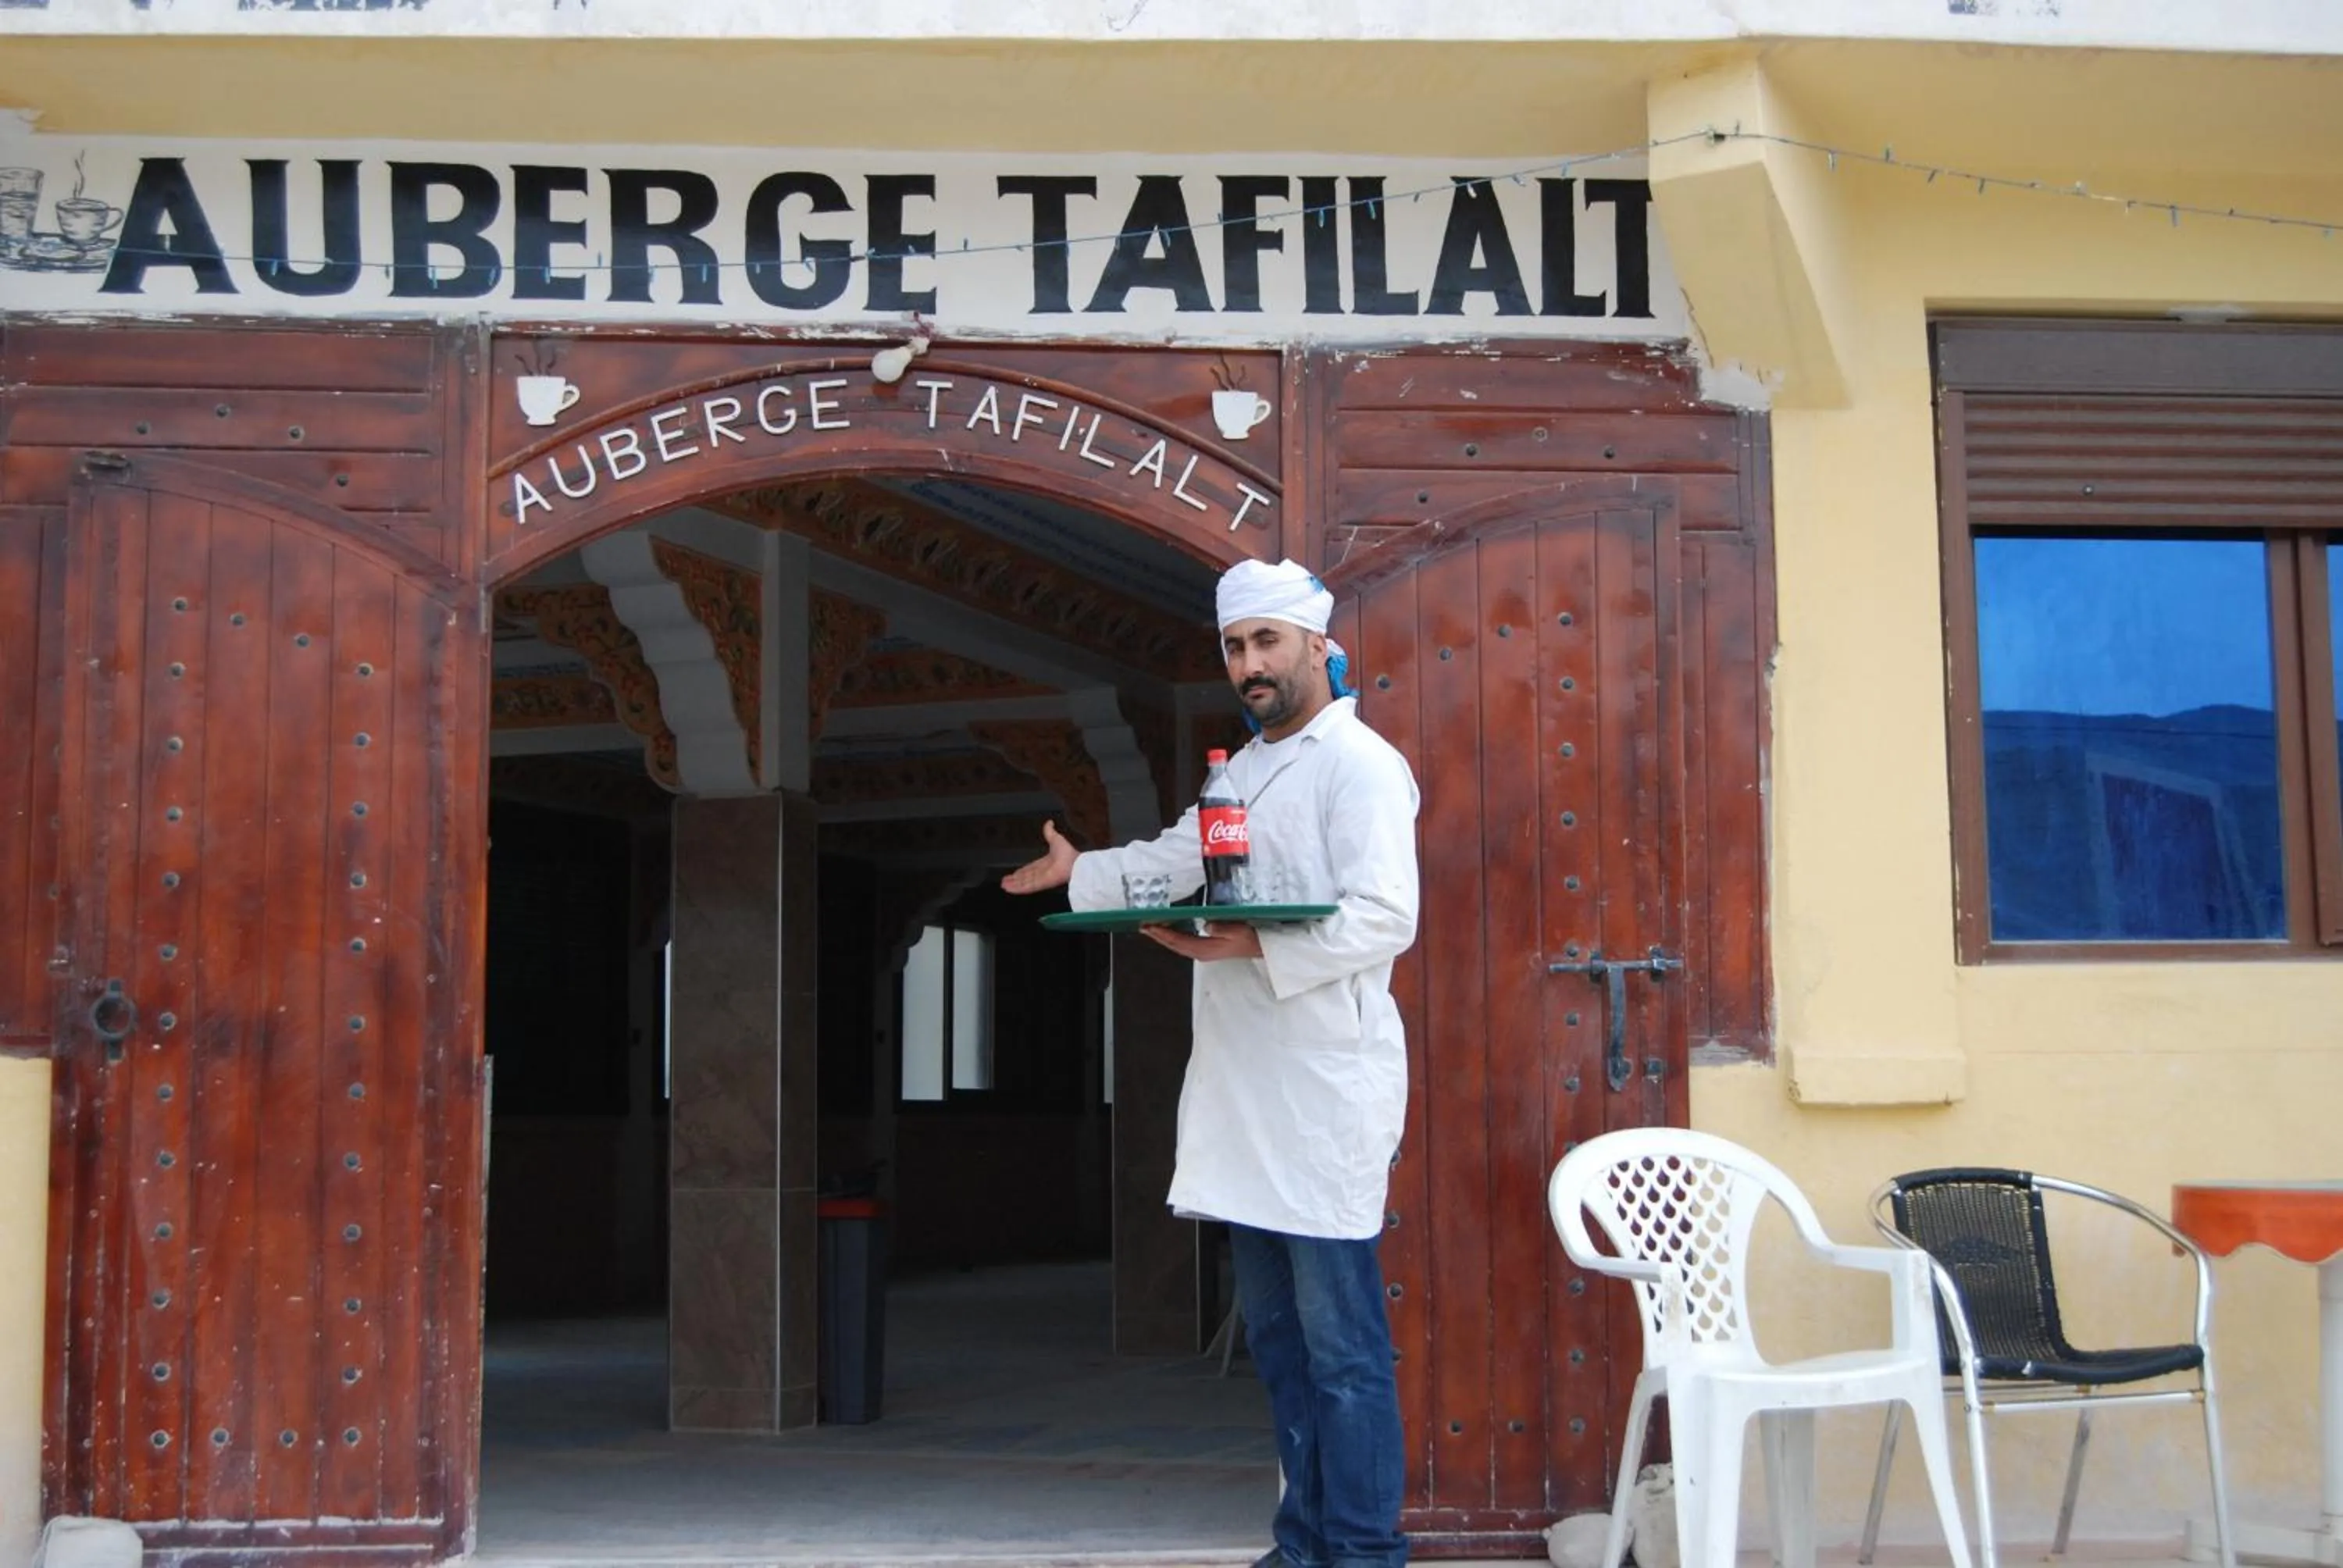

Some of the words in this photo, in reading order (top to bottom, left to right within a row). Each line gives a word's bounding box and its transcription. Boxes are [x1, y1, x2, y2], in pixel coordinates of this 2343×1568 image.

[98, 156, 936, 314] AUBERGE
[997, 174, 1656, 318] TAFILALT
[512, 379, 851, 524] AUBERGE
[915, 380, 1270, 532] TAFILALT
